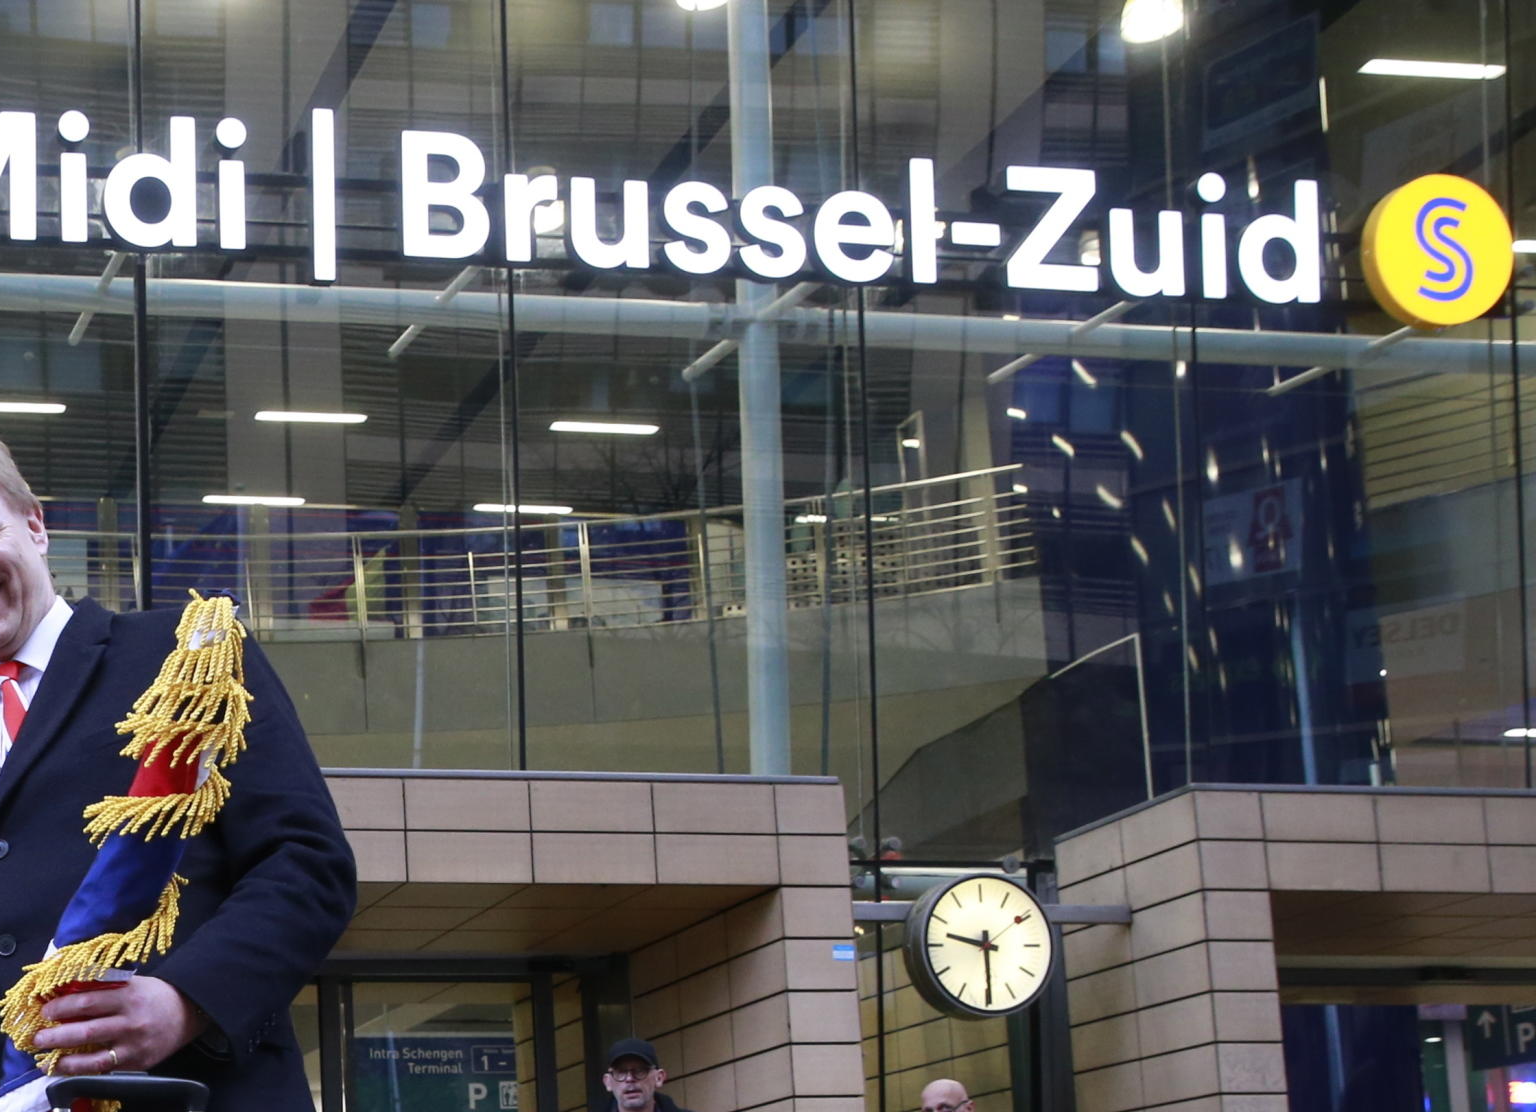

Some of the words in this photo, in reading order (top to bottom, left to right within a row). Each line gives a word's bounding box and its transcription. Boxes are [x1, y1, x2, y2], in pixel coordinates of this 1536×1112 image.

[400, 130, 1322, 305] Brussel-Zuid
[369, 1048, 399, 1060] Intra
[402, 1048, 464, 1062] Schengen
[407, 1062, 464, 1075] Terminal
[468, 1083, 488, 1110] P
